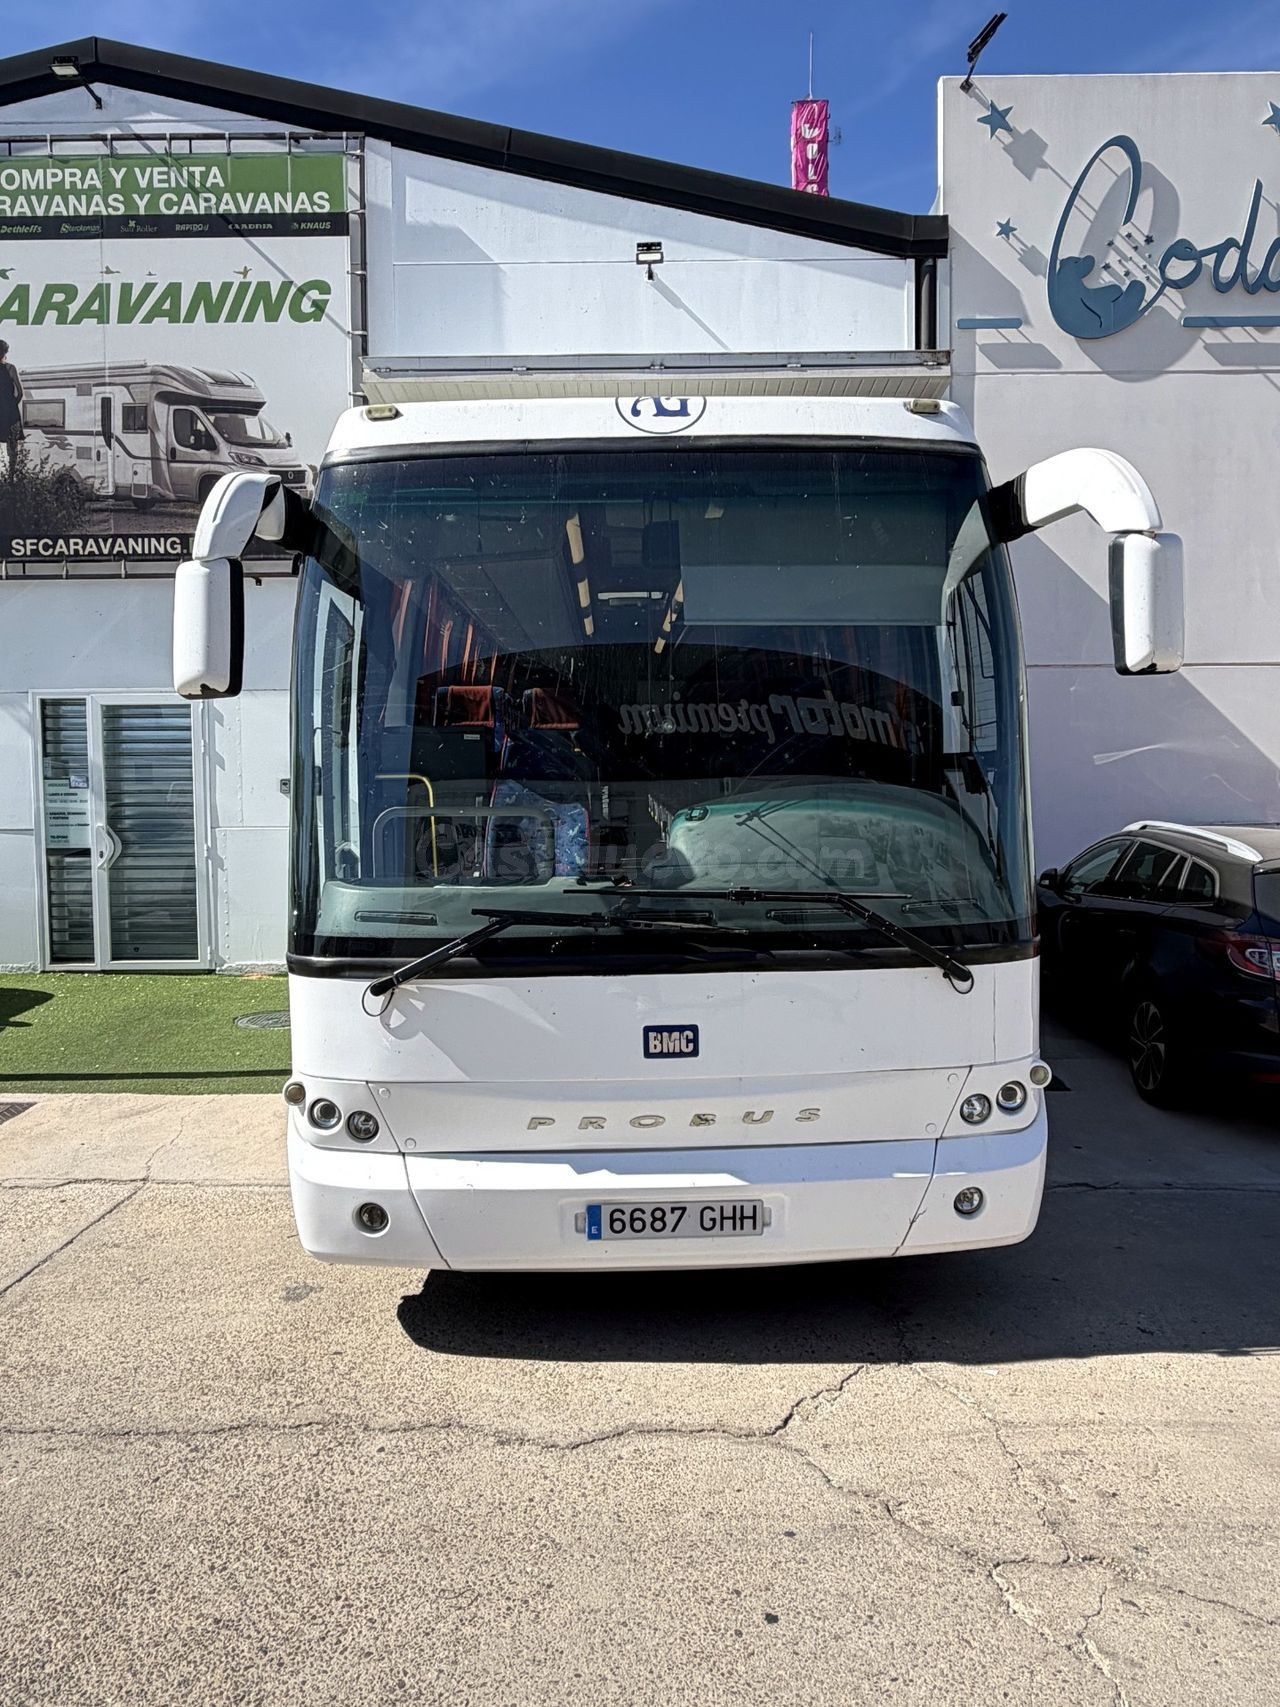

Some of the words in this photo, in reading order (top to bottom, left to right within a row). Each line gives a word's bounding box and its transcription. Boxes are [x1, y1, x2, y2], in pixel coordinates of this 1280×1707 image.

[108, 167, 127, 189] Y
[134, 166, 224, 188] VENTA
[132, 195, 150, 215] Y
[159, 192, 331, 215] CARAVANAS
[300, 221, 331, 230] KNAUS
[0, 279, 331, 325] ARAVANING
[648, 1030, 695, 1055] BMC
[526, 1108, 821, 1131] PROBUS
[608, 1207, 688, 1234] 6687
[699, 1205, 757, 1232] GHH
